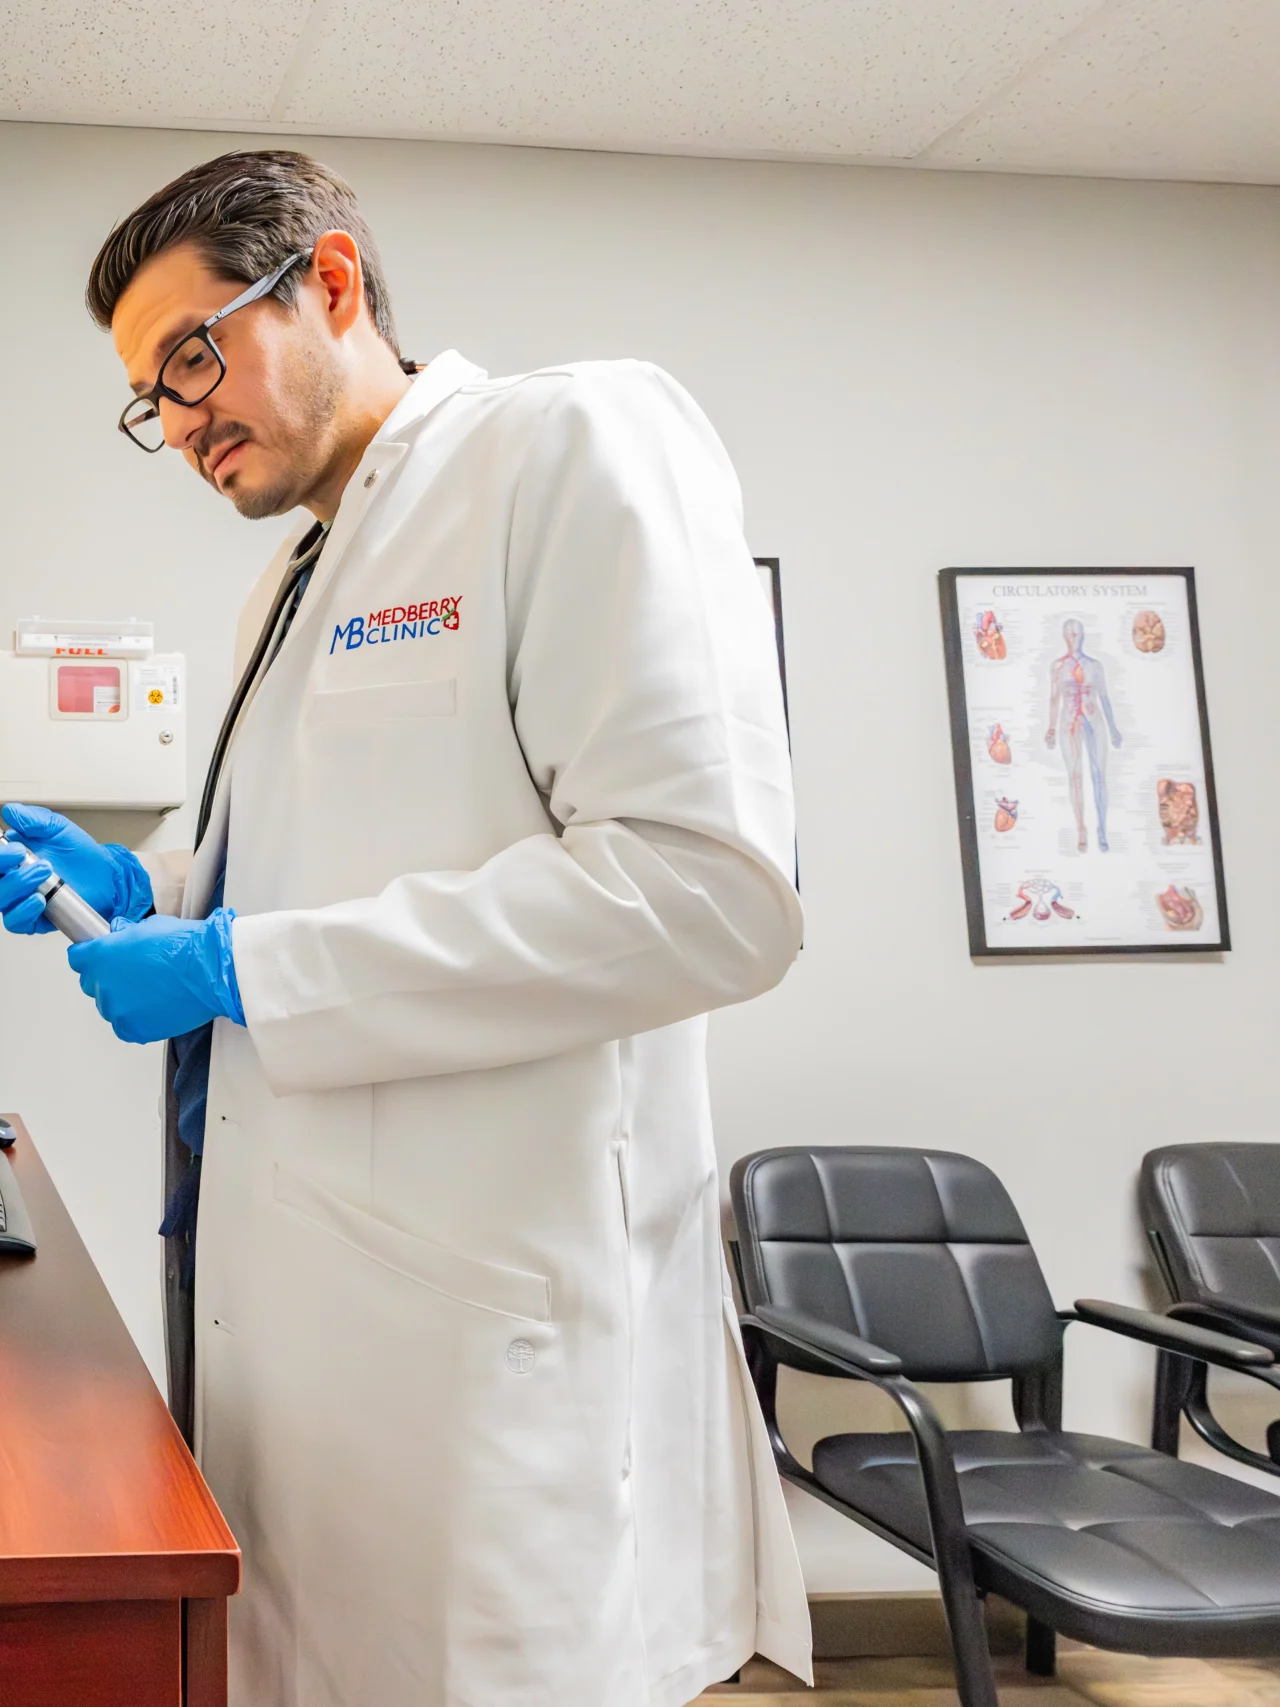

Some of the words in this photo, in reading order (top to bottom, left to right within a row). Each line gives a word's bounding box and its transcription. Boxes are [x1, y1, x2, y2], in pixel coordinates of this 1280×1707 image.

[992, 584, 1089, 598] CIRCULATORY
[1092, 585, 1148, 597] SYSTEM
[367, 595, 463, 628] MEDBERRY
[329, 616, 365, 655] MB
[366, 618, 441, 644] CLINIC
[55, 647, 108, 655] FULL
